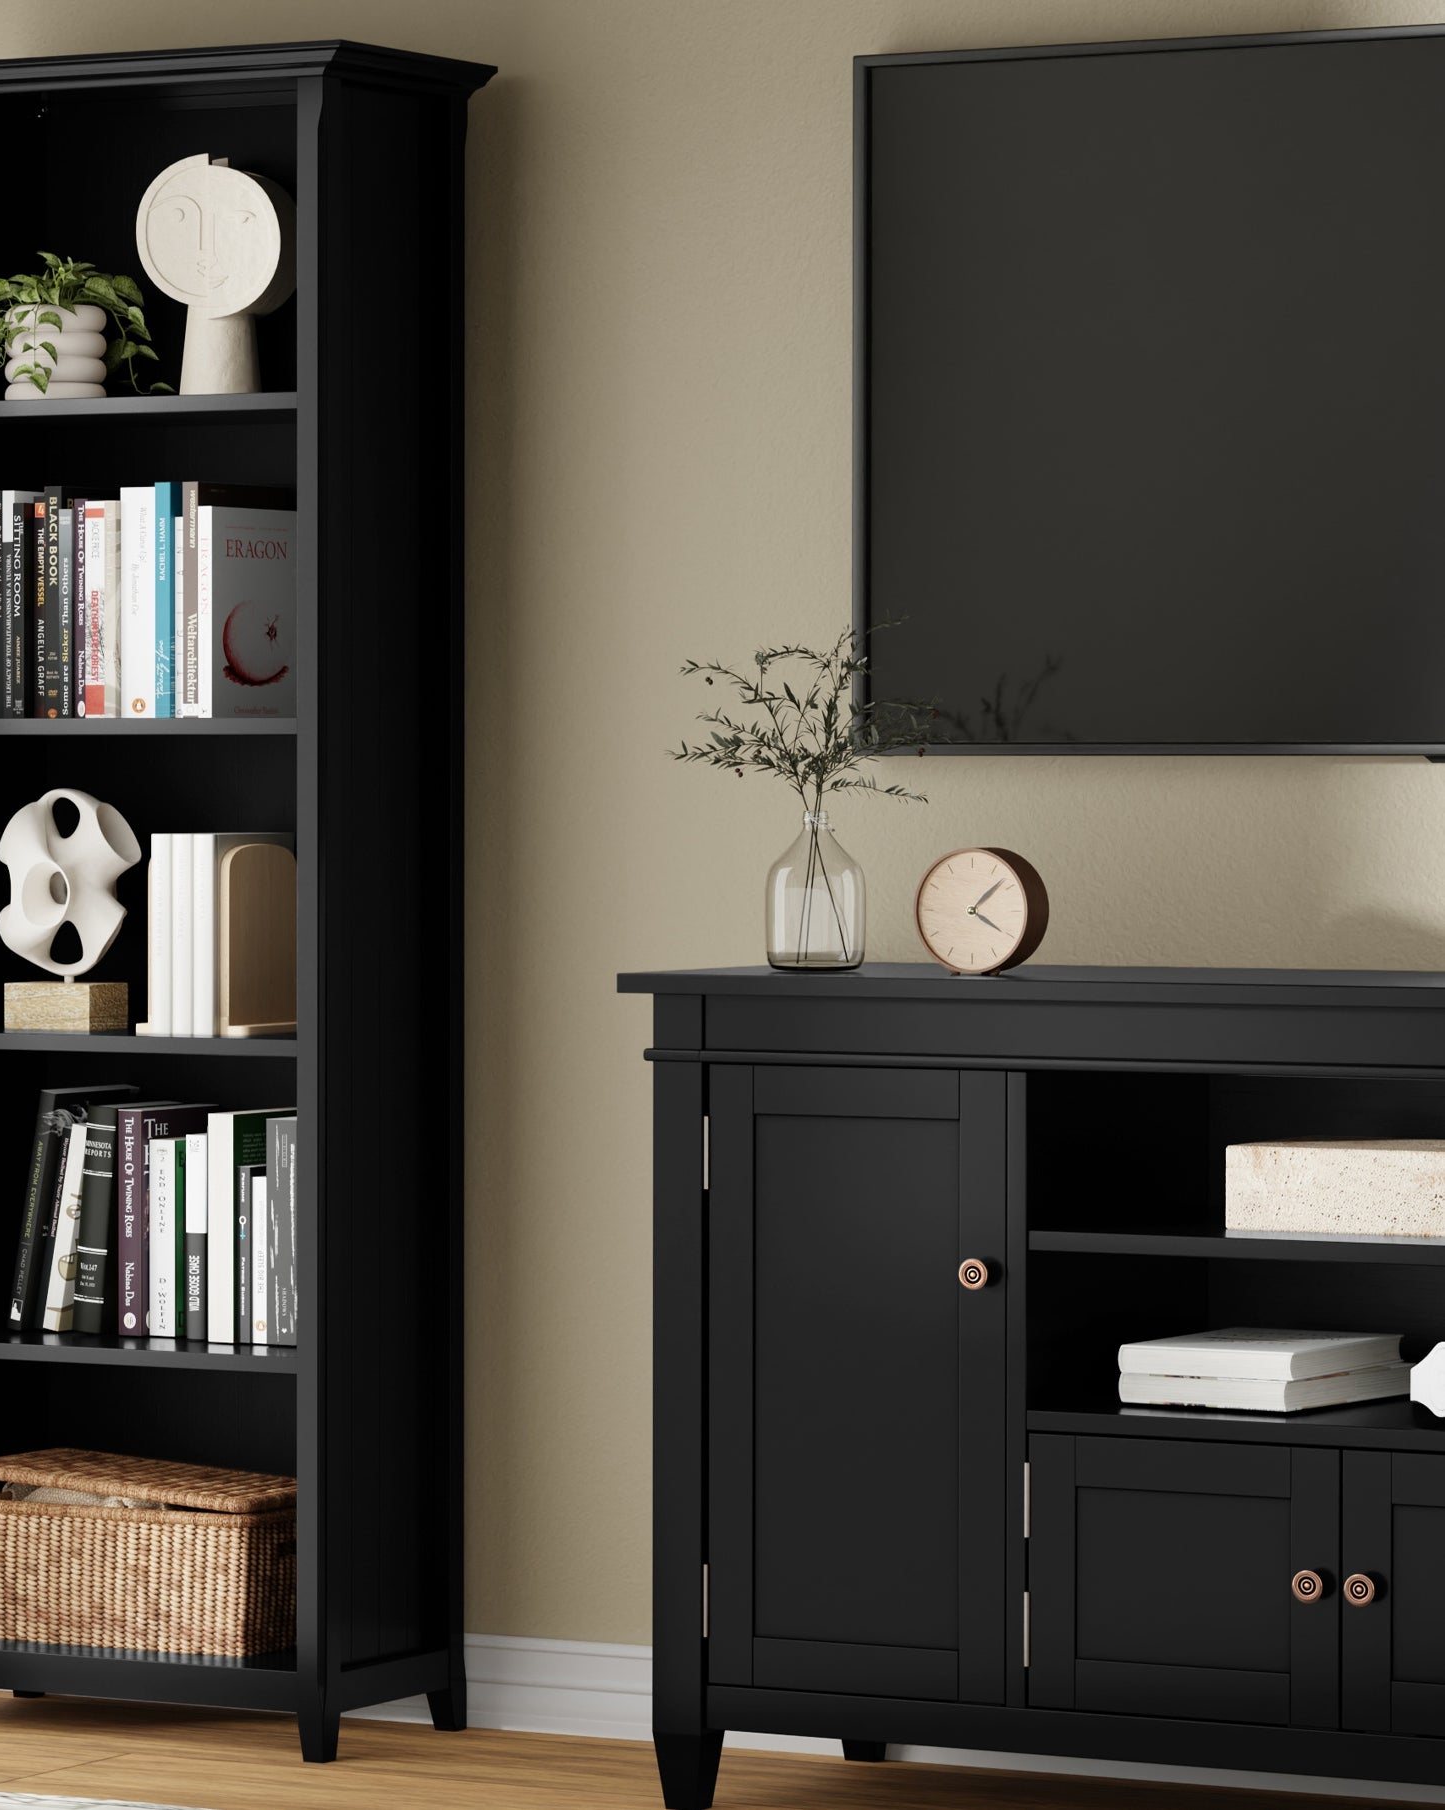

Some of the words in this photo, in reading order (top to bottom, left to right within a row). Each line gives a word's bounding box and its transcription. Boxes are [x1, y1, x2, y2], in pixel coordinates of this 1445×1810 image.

[49, 496, 58, 542] BLACK
[77, 505, 85, 522] THE
[37, 528, 45, 545] THE
[226, 538, 288, 560] ERAGON
[37, 546, 45, 576] EMPTY
[49, 546, 58, 586] BOOK
[200, 537, 209, 615] ERAGON
[37, 577, 45, 607] VESSEL
[37, 619, 45, 662] ANGELLA
[6, 657, 11, 667] OF
[187, 613, 198, 704] Weltarchitektur
[37, 665, 45, 696] GRAFF
[125, 1117, 134, 1134] THE
[144, 1119, 169, 1139] THE
[35, 1141, 44, 1162] AWAY
[125, 1177, 134, 1213] TWINING
[24, 1187, 37, 1238] EVERYWHERE
[20, 1248, 28, 1268] CHAD
[189, 1255, 200, 1275] CHASE
[125, 1262, 135, 1291] Nabina
[189, 1275, 200, 1296] GOOSE
[125, 1291, 135, 1306] Das
[189, 1296, 200, 1312] WILD
